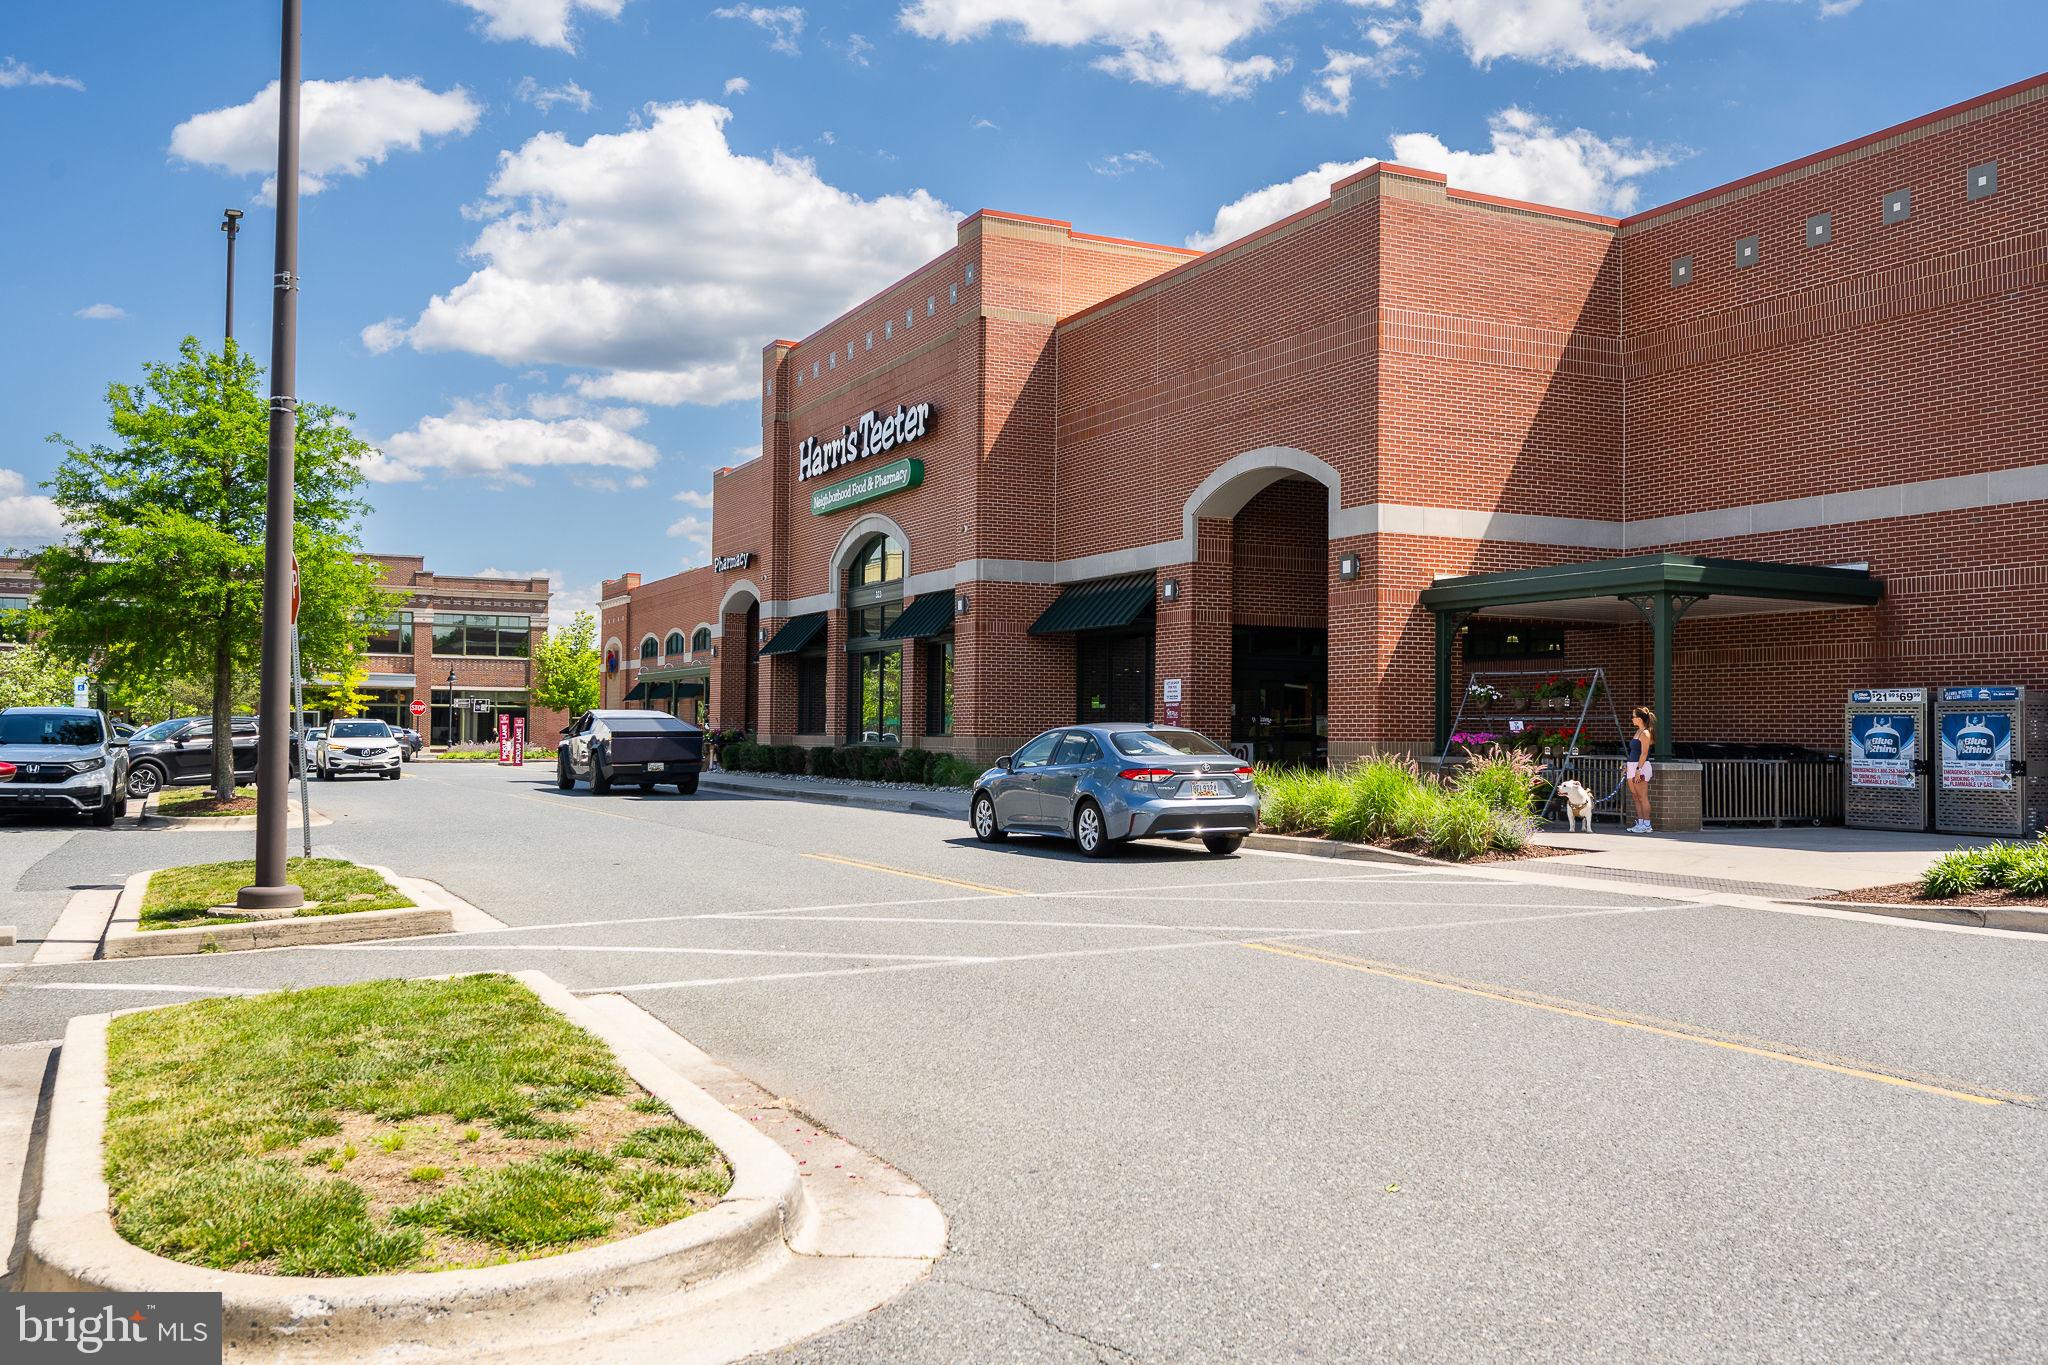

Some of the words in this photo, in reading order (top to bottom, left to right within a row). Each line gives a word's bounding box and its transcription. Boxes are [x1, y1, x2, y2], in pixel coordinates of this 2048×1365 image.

[798, 426, 857, 482] Harris
[859, 402, 929, 457] Teeter
[813, 485, 851, 510] Neighborhood
[852, 480, 867, 496] Food
[867, 476, 874, 491] &
[874, 469, 907, 490] Pharmacy
[714, 552, 749, 573] Pharmacy
[1871, 737, 1893, 745] Blue
[1964, 737, 1987, 745] Blue
